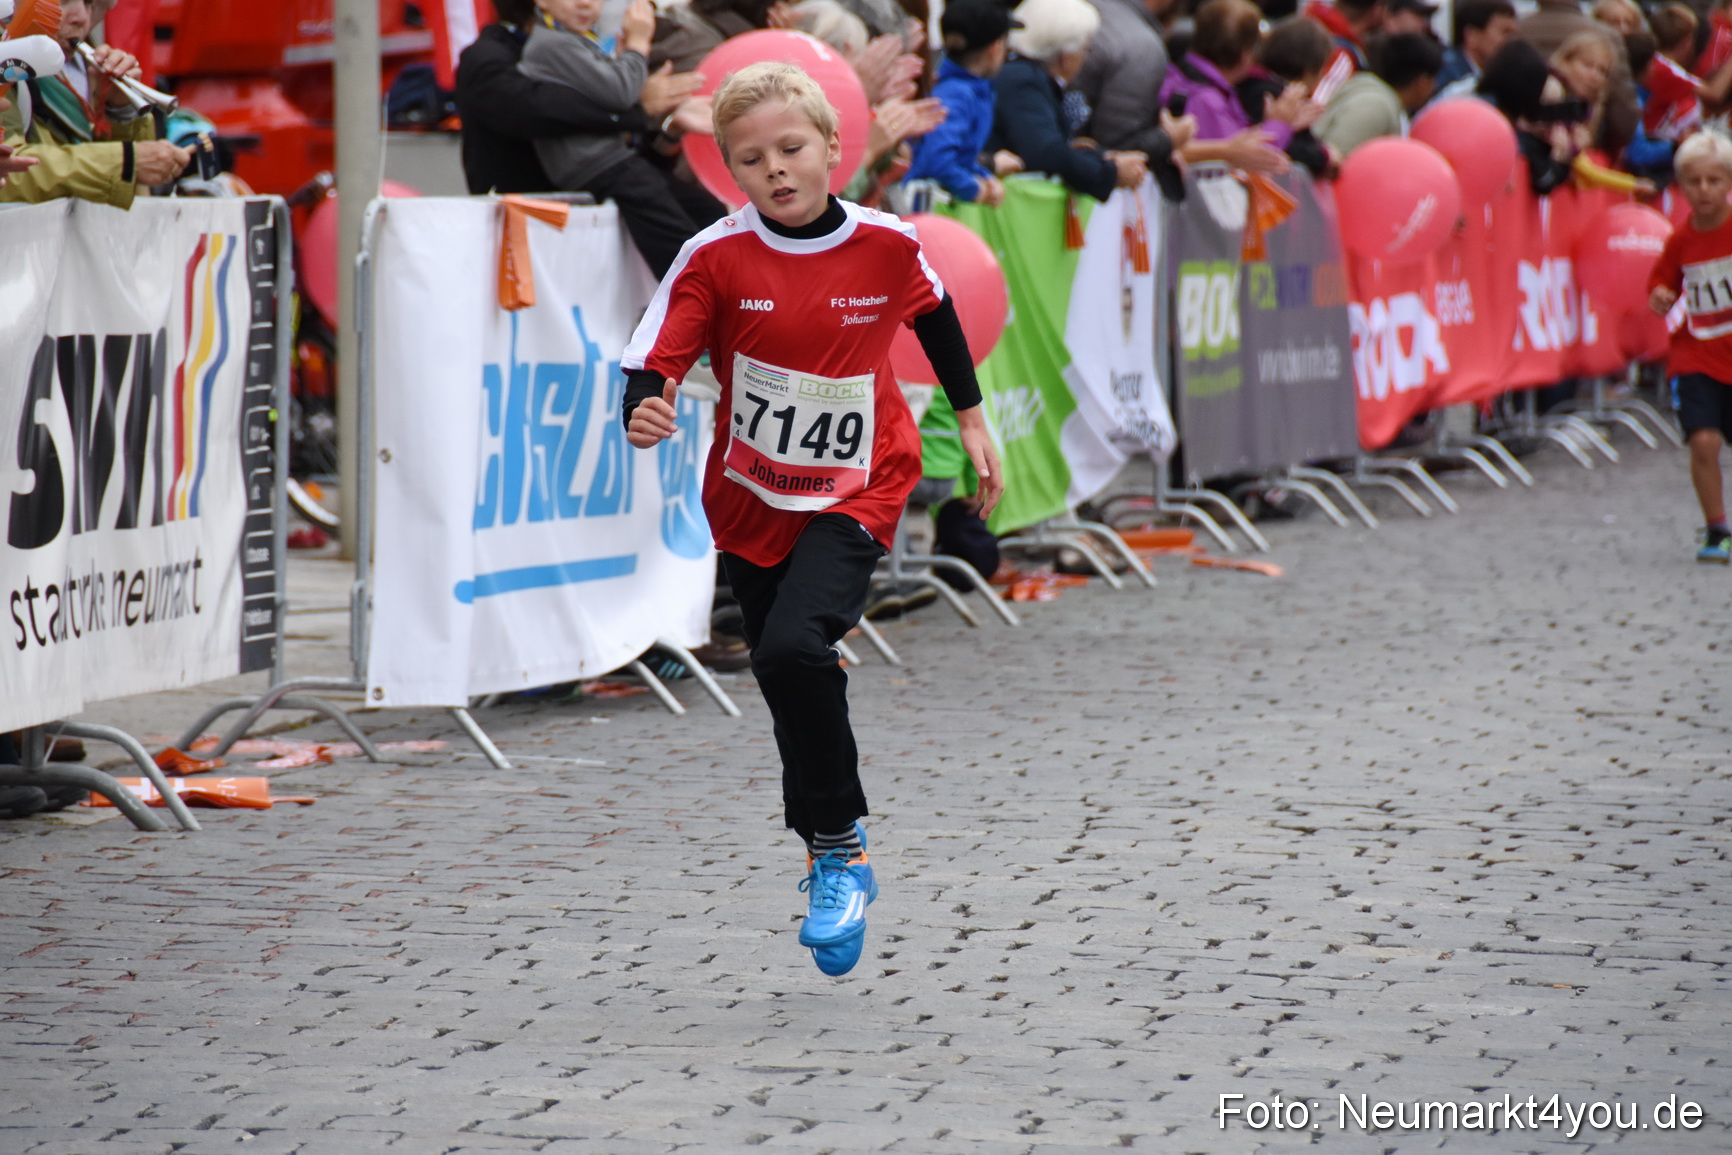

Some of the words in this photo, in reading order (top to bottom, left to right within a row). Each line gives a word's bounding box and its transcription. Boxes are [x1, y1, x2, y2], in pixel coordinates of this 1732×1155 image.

[739, 298, 775, 312] JAKO
[830, 298, 846, 308] FC
[848, 295, 889, 307] Holzheim
[743, 371, 790, 394] NeuerMarkt
[799, 377, 867, 399] BOCK
[744, 391, 864, 460] 7149
[748, 457, 836, 493] Johannes
